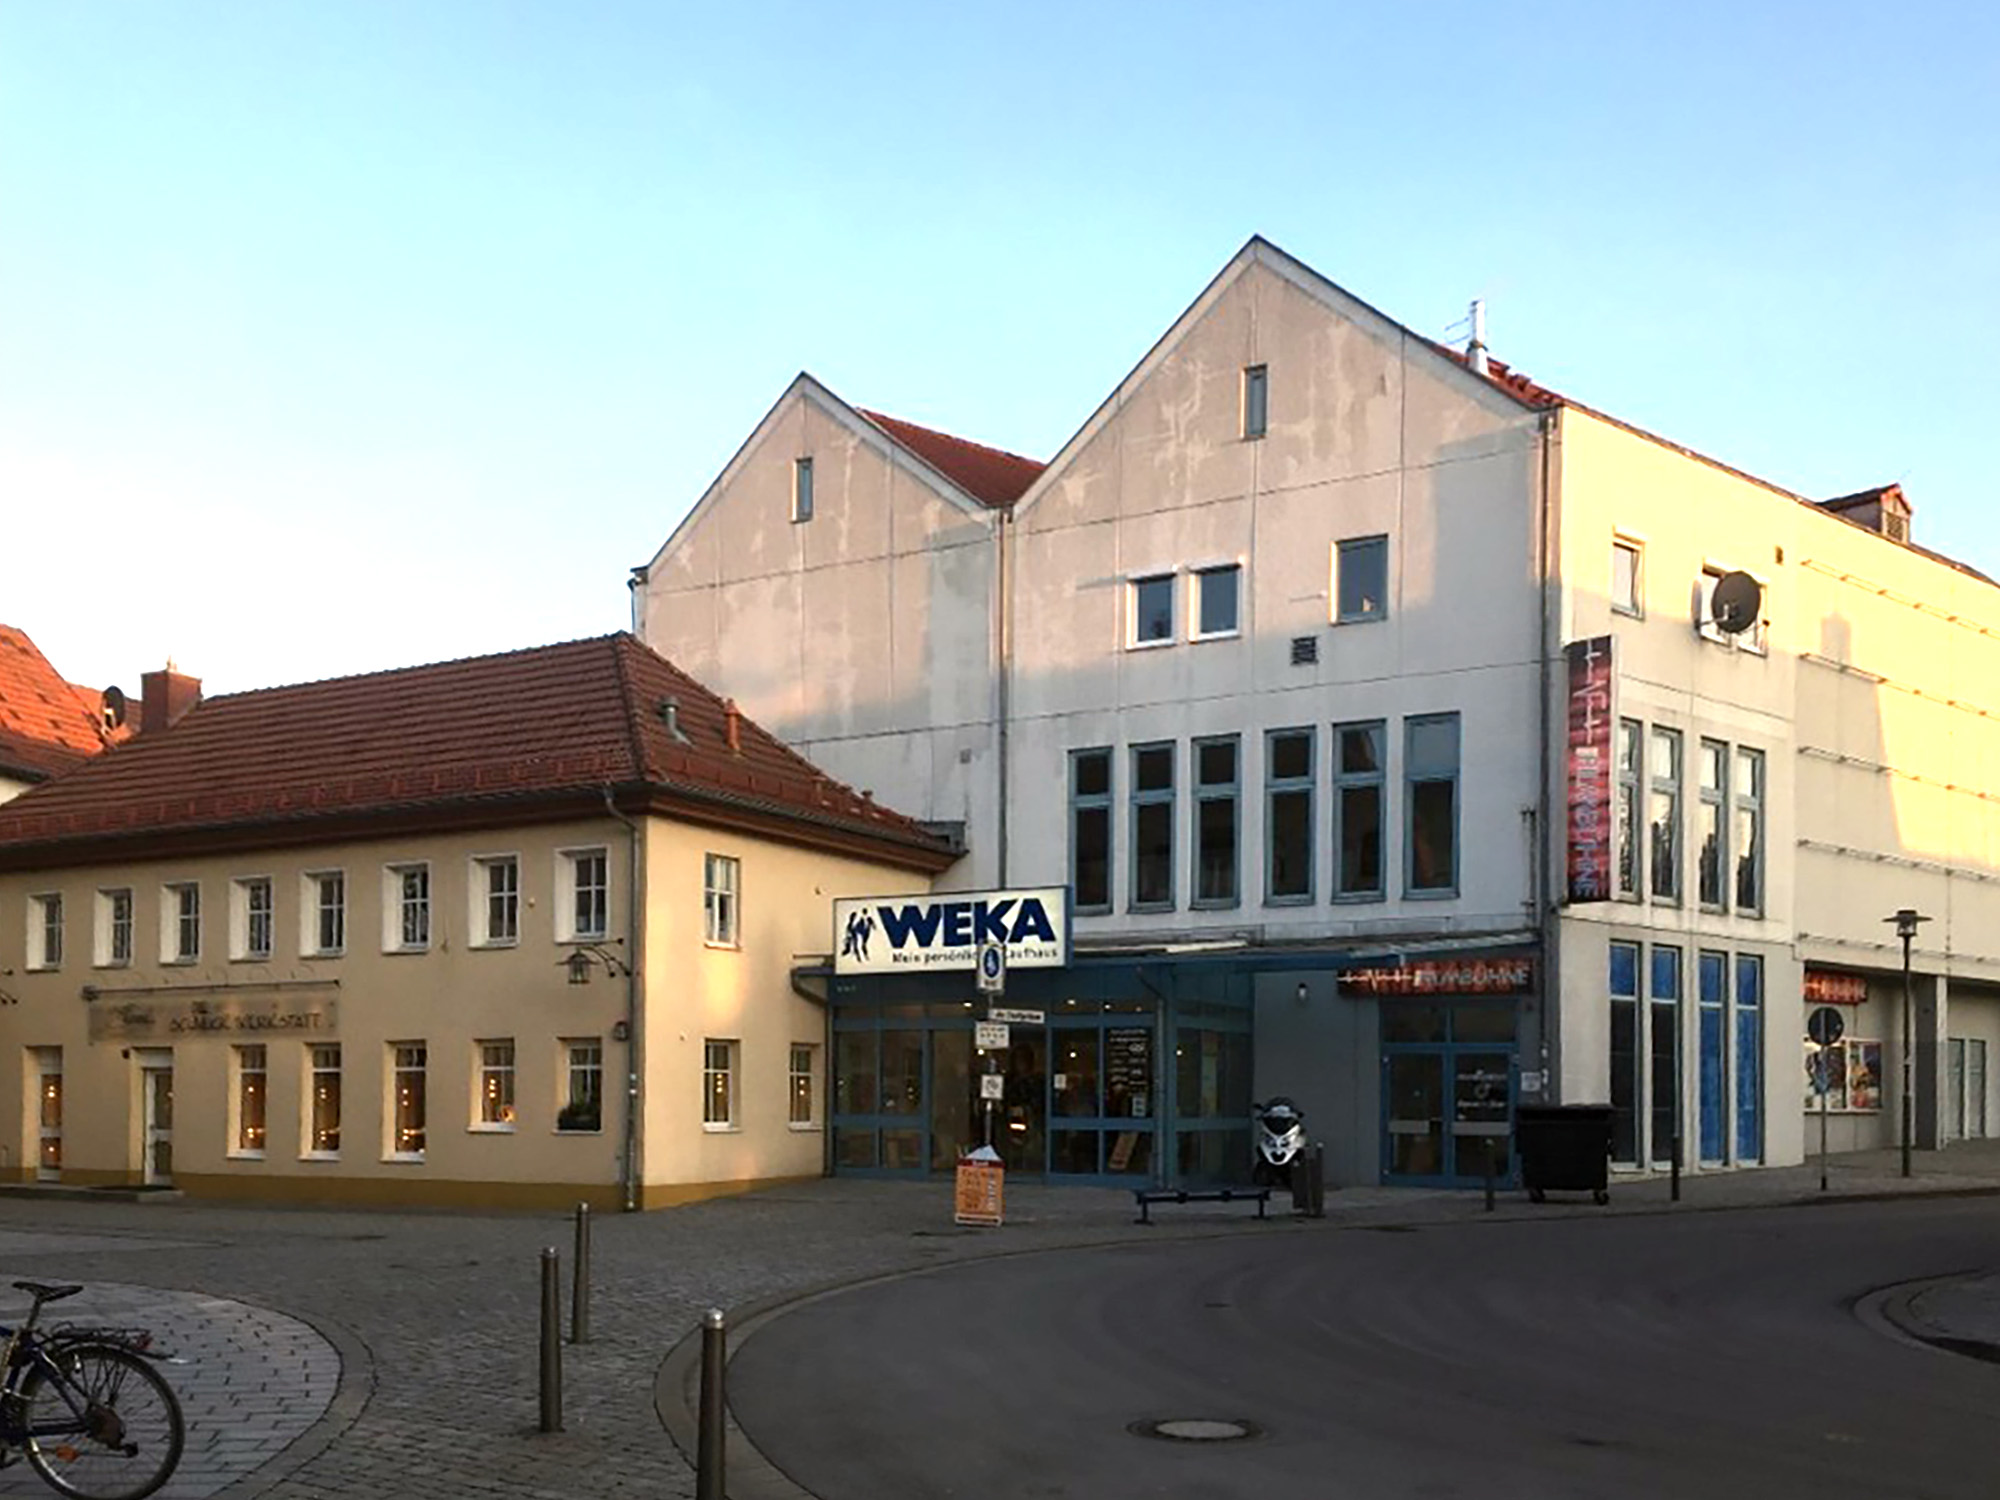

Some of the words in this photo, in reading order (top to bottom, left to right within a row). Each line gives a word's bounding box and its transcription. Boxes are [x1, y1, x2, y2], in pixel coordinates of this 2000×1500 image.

[877, 897, 1057, 949] WEKA
[892, 952, 921, 964] Mein
[1006, 948, 1057, 959] aufhaus
